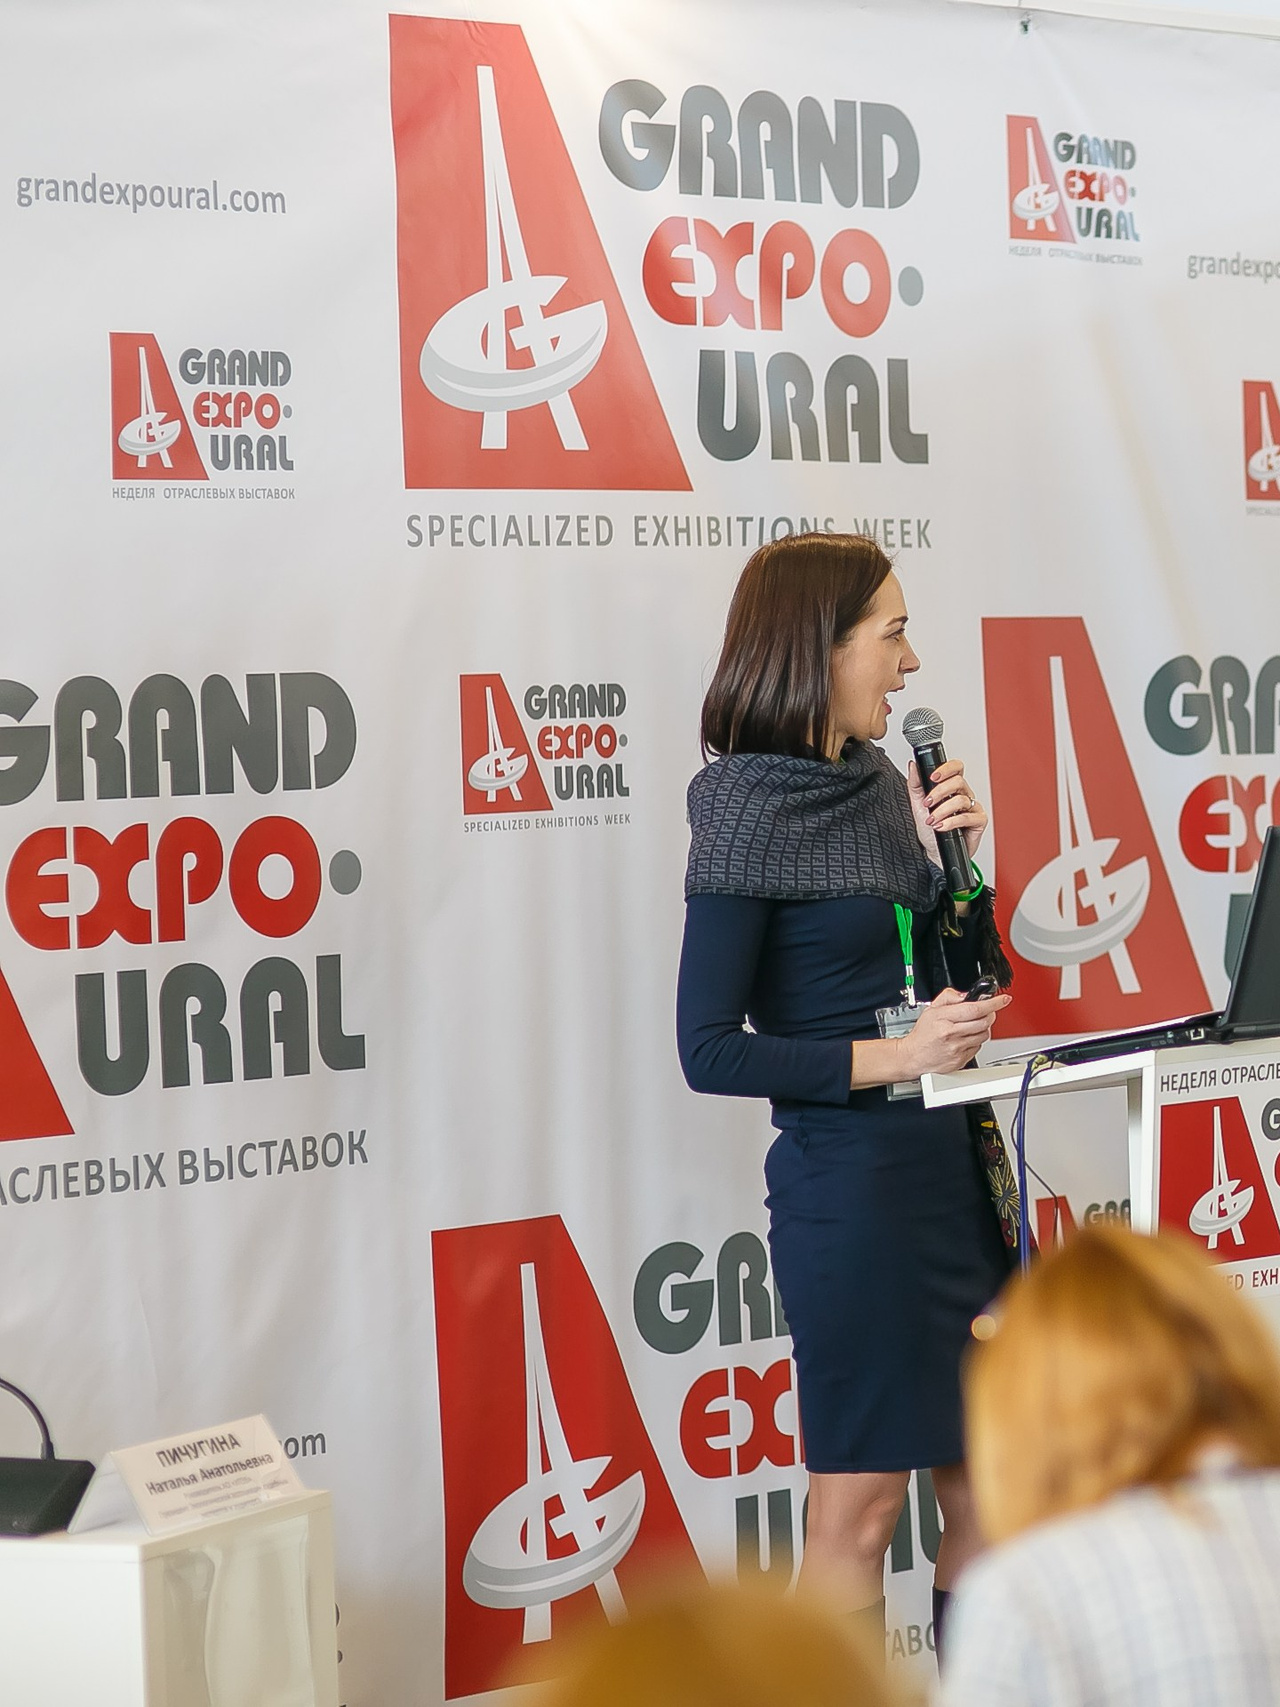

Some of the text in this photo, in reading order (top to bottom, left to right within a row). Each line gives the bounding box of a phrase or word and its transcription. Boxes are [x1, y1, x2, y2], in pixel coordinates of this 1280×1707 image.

[599, 79, 920, 209] GRAND
[16, 172, 286, 215] grandexpoural.com
[1076, 207, 1140, 242] URAL
[179, 348, 291, 387] GRAND
[697, 349, 929, 464] URAL
[210, 434, 294, 471] URAL
[112, 487, 295, 500] НЕДЕЛЯ ОТРАСЛЕВЫХ ВЫСТАВОК
[406, 514, 614, 548] SPECIALIZED
[853, 517, 932, 549] WEEK
[524, 683, 626, 720] GRAND
[554, 764, 629, 800] URAL
[464, 813, 631, 833] SPECIALIZED EXHIBITIONS WEEK
[75, 954, 366, 1096] URAL
[1160, 1069, 1217, 1094] НЕДЕЛЯ
[178, 1129, 369, 1186] ВЫСТАВОК
[156, 1433, 242, 1467] ПИЧУГИНА
[145, 1473, 198, 1496] Наталья
[199, 1453, 274, 1480] Анатольевна
